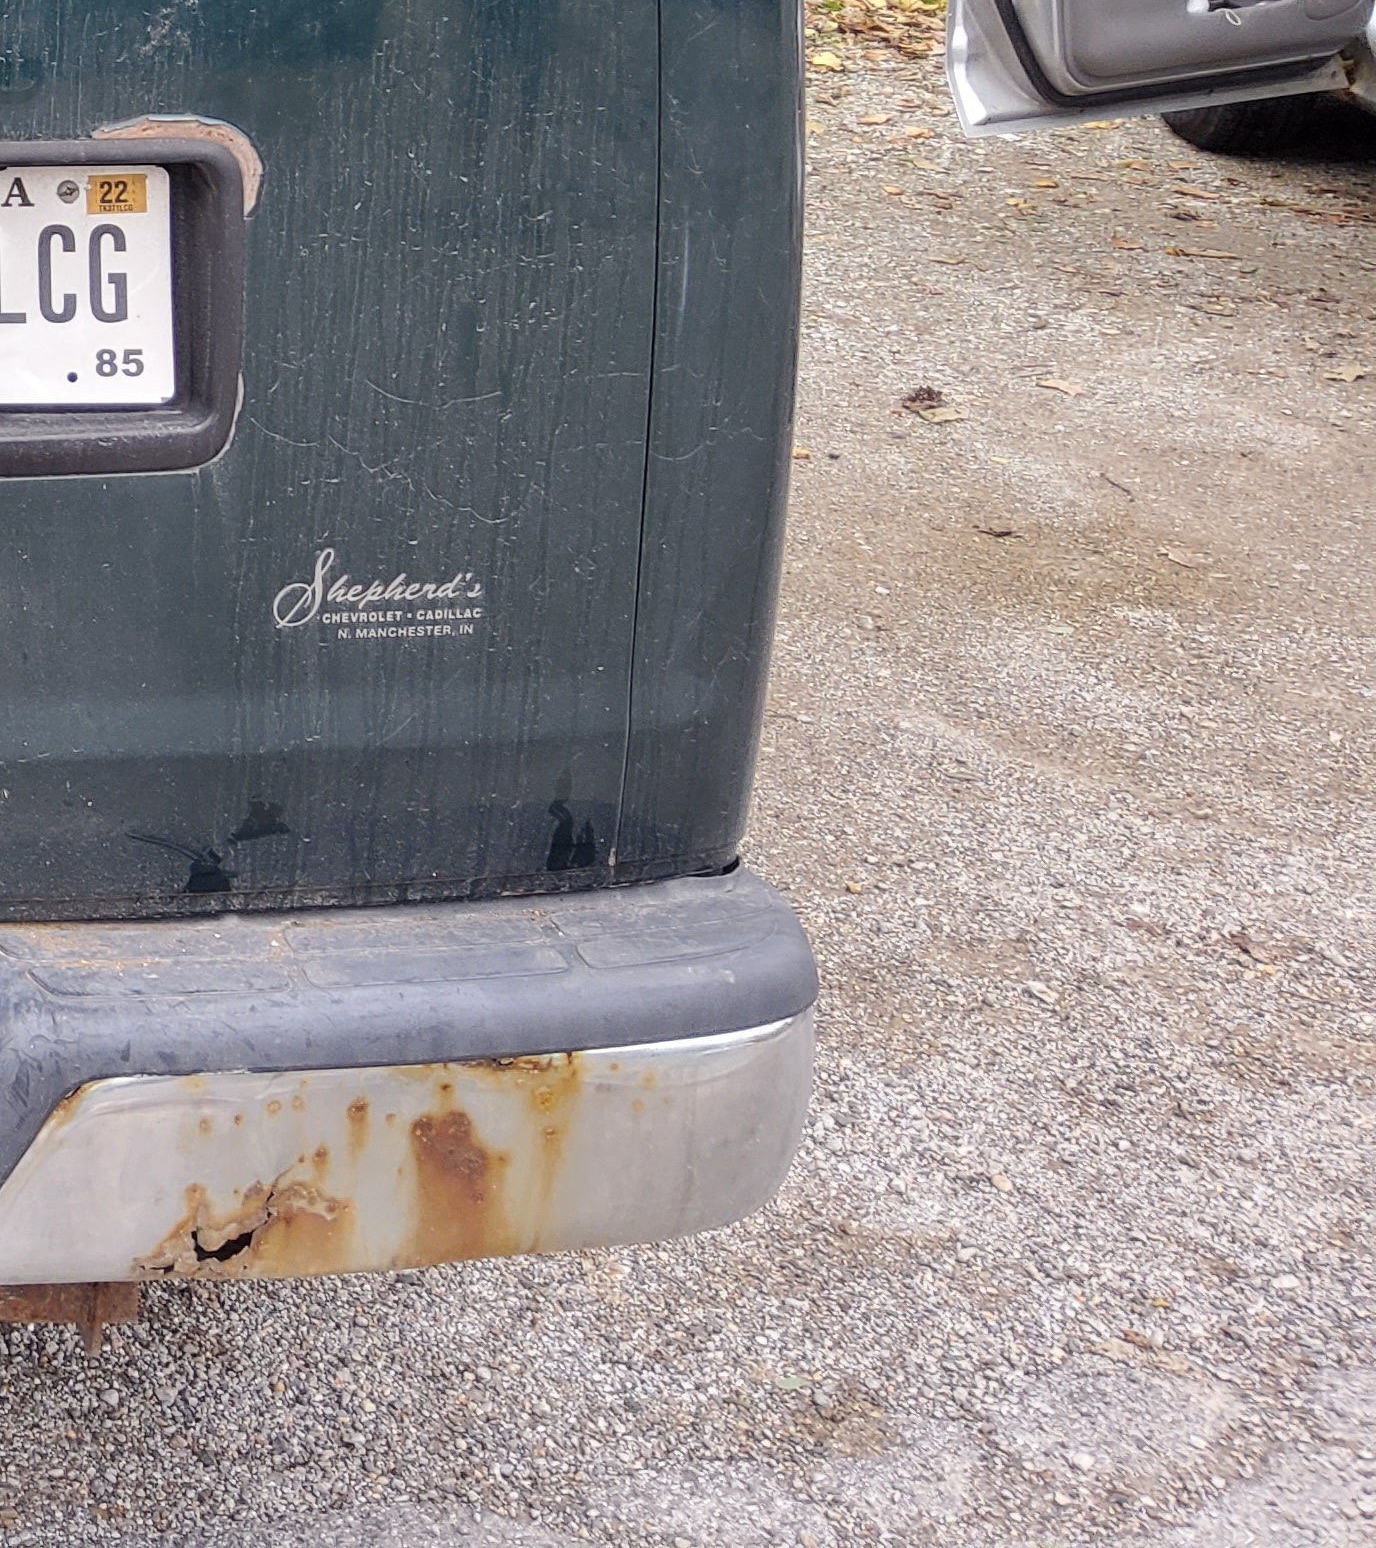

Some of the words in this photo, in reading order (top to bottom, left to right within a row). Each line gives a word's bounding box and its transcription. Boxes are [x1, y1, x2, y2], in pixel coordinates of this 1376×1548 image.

[99, 180, 129, 204] 22
[95, 348, 145, 377] 85
[272, 547, 483, 629] Shepherd's
[322, 610, 403, 624] CHEVROLET
[416, 607, 483, 621] CADILLAC
[337, 628, 352, 640] N.
[355, 624, 456, 639] MANCHESTER,
[459, 623, 474, 636] IN
